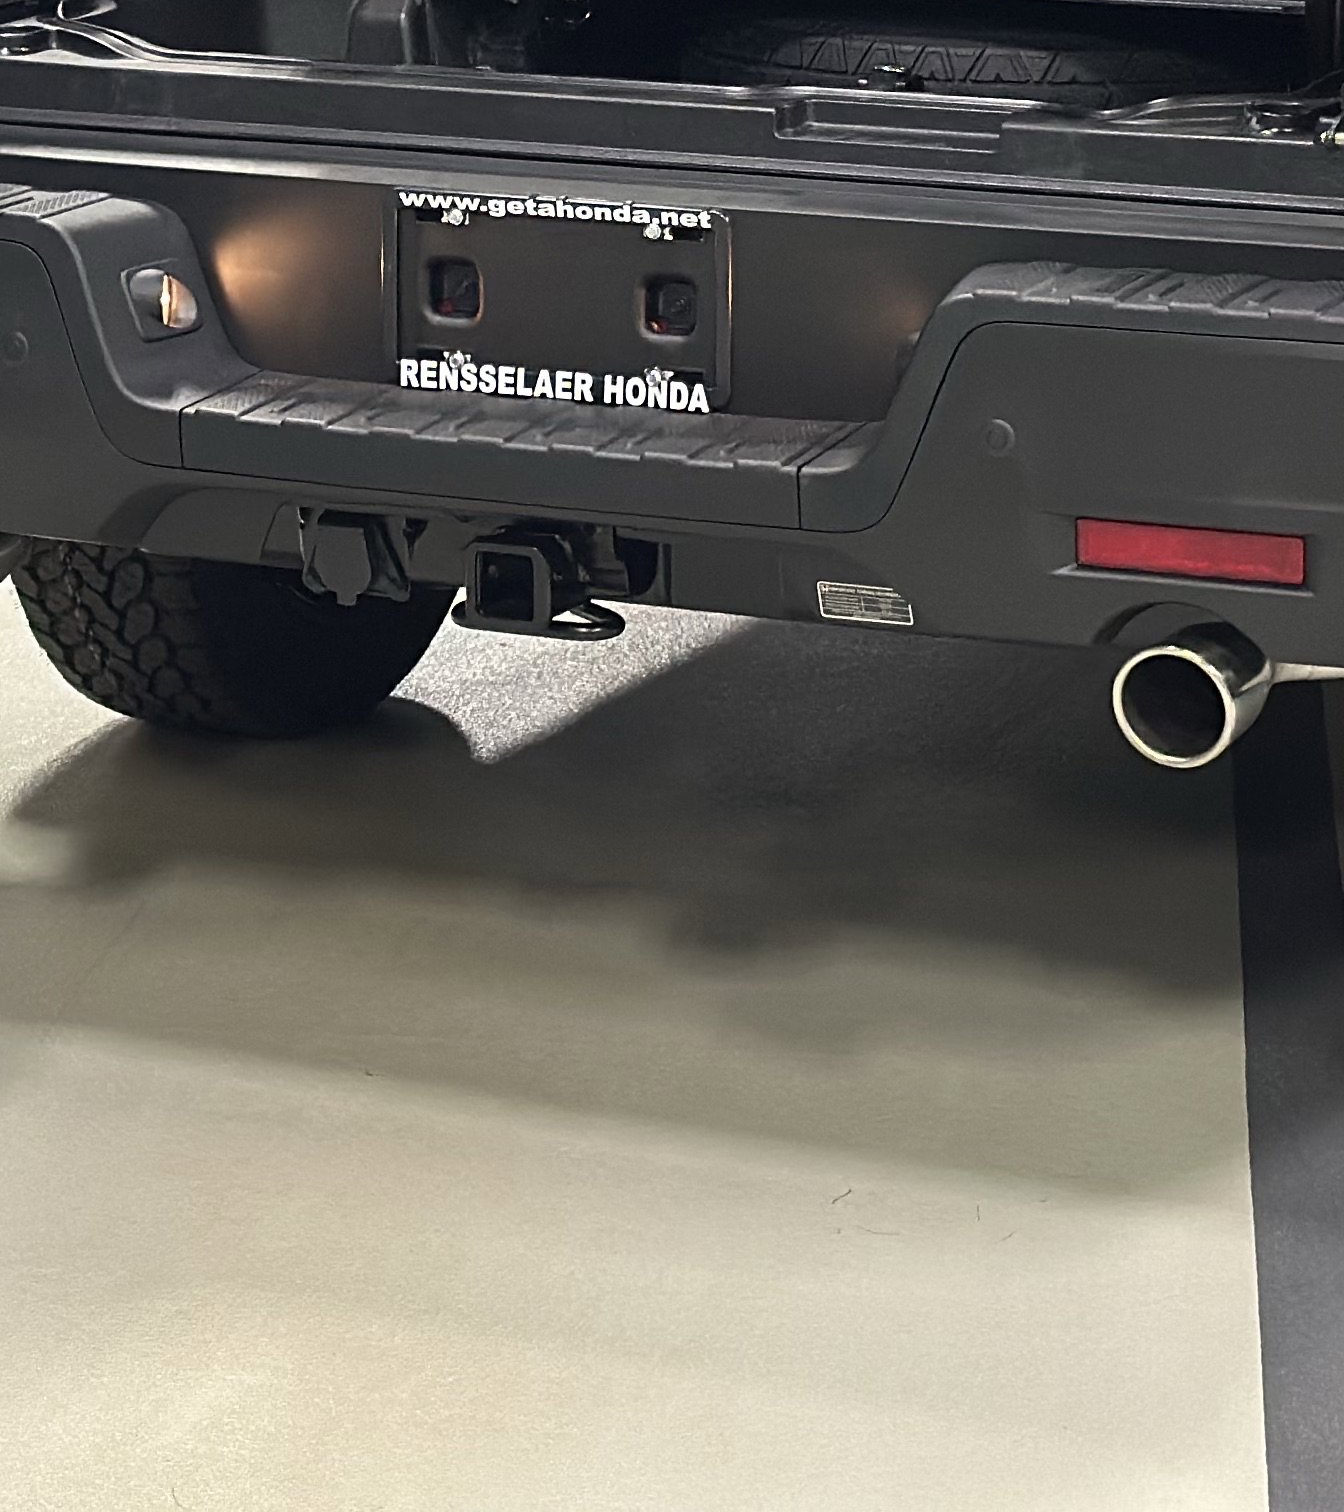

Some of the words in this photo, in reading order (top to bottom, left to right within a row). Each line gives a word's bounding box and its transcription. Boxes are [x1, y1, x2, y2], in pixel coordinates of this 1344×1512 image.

[399, 191, 712, 229] www.getahonda.net
[400, 358, 594, 403] RENSSELAER
[603, 373, 710, 414] HONDA
